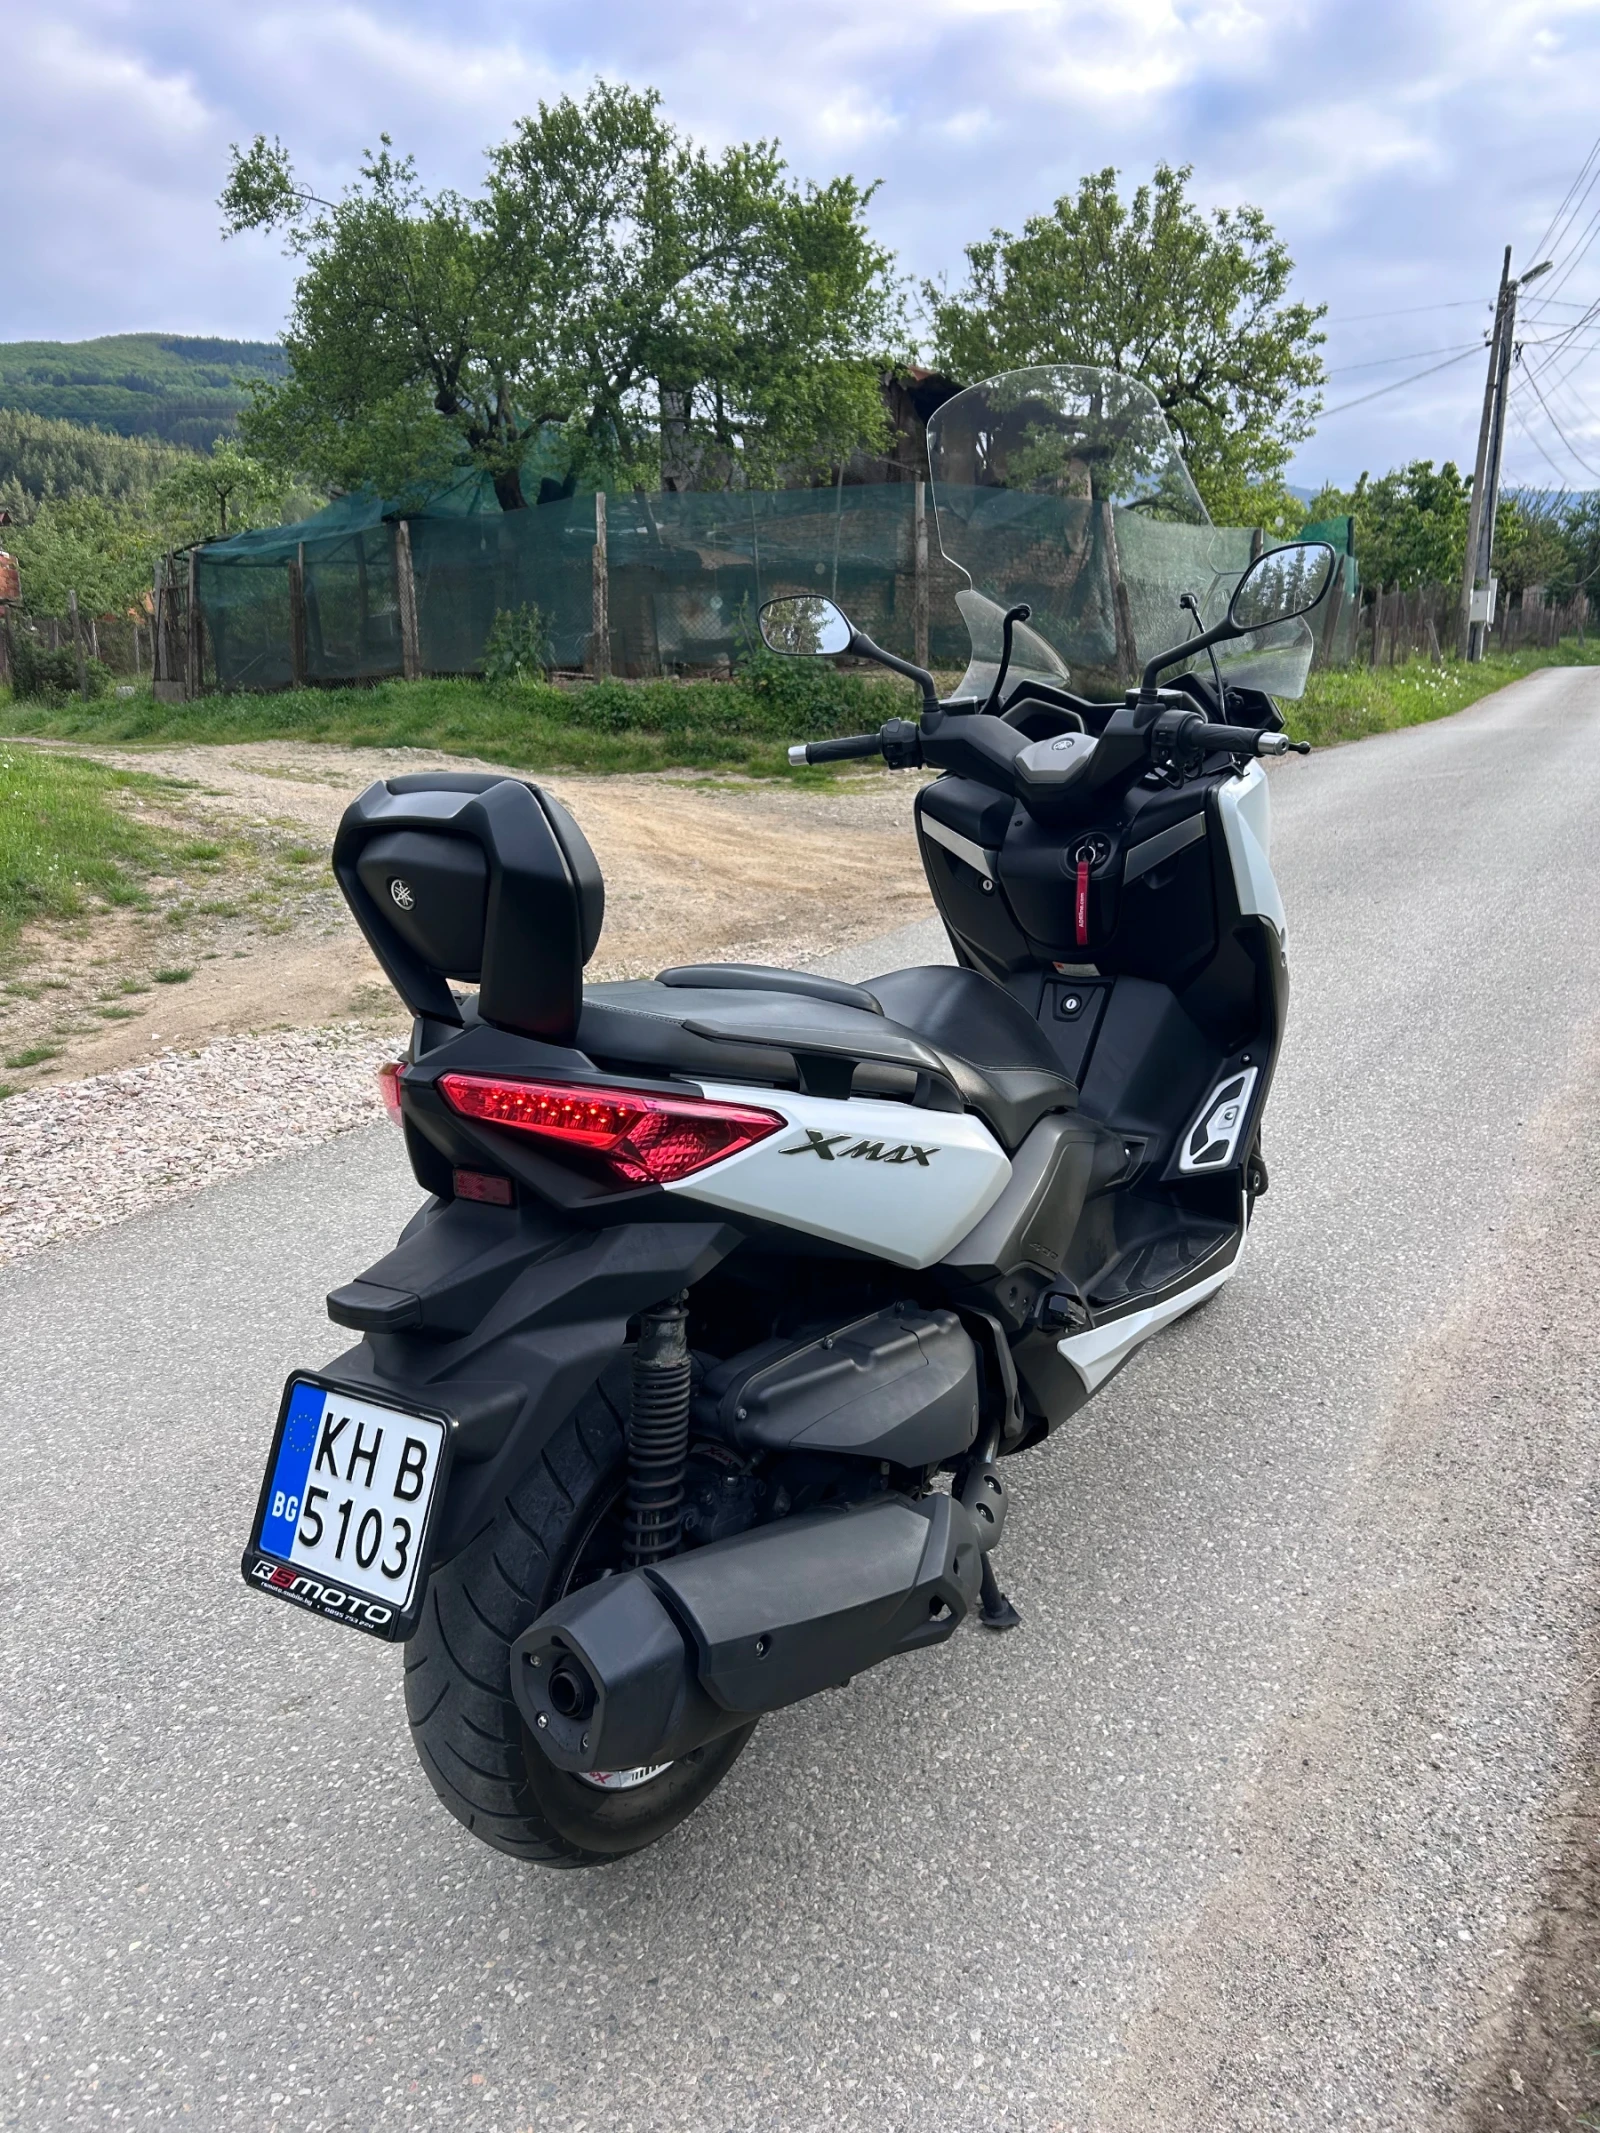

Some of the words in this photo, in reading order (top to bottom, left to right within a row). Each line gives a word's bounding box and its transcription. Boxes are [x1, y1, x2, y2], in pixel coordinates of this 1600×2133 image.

[314, 1412, 384, 1488] KH
[393, 1436, 428, 1502] B
[272, 1491, 299, 1523] BG
[298, 1485, 412, 1580] 5103
